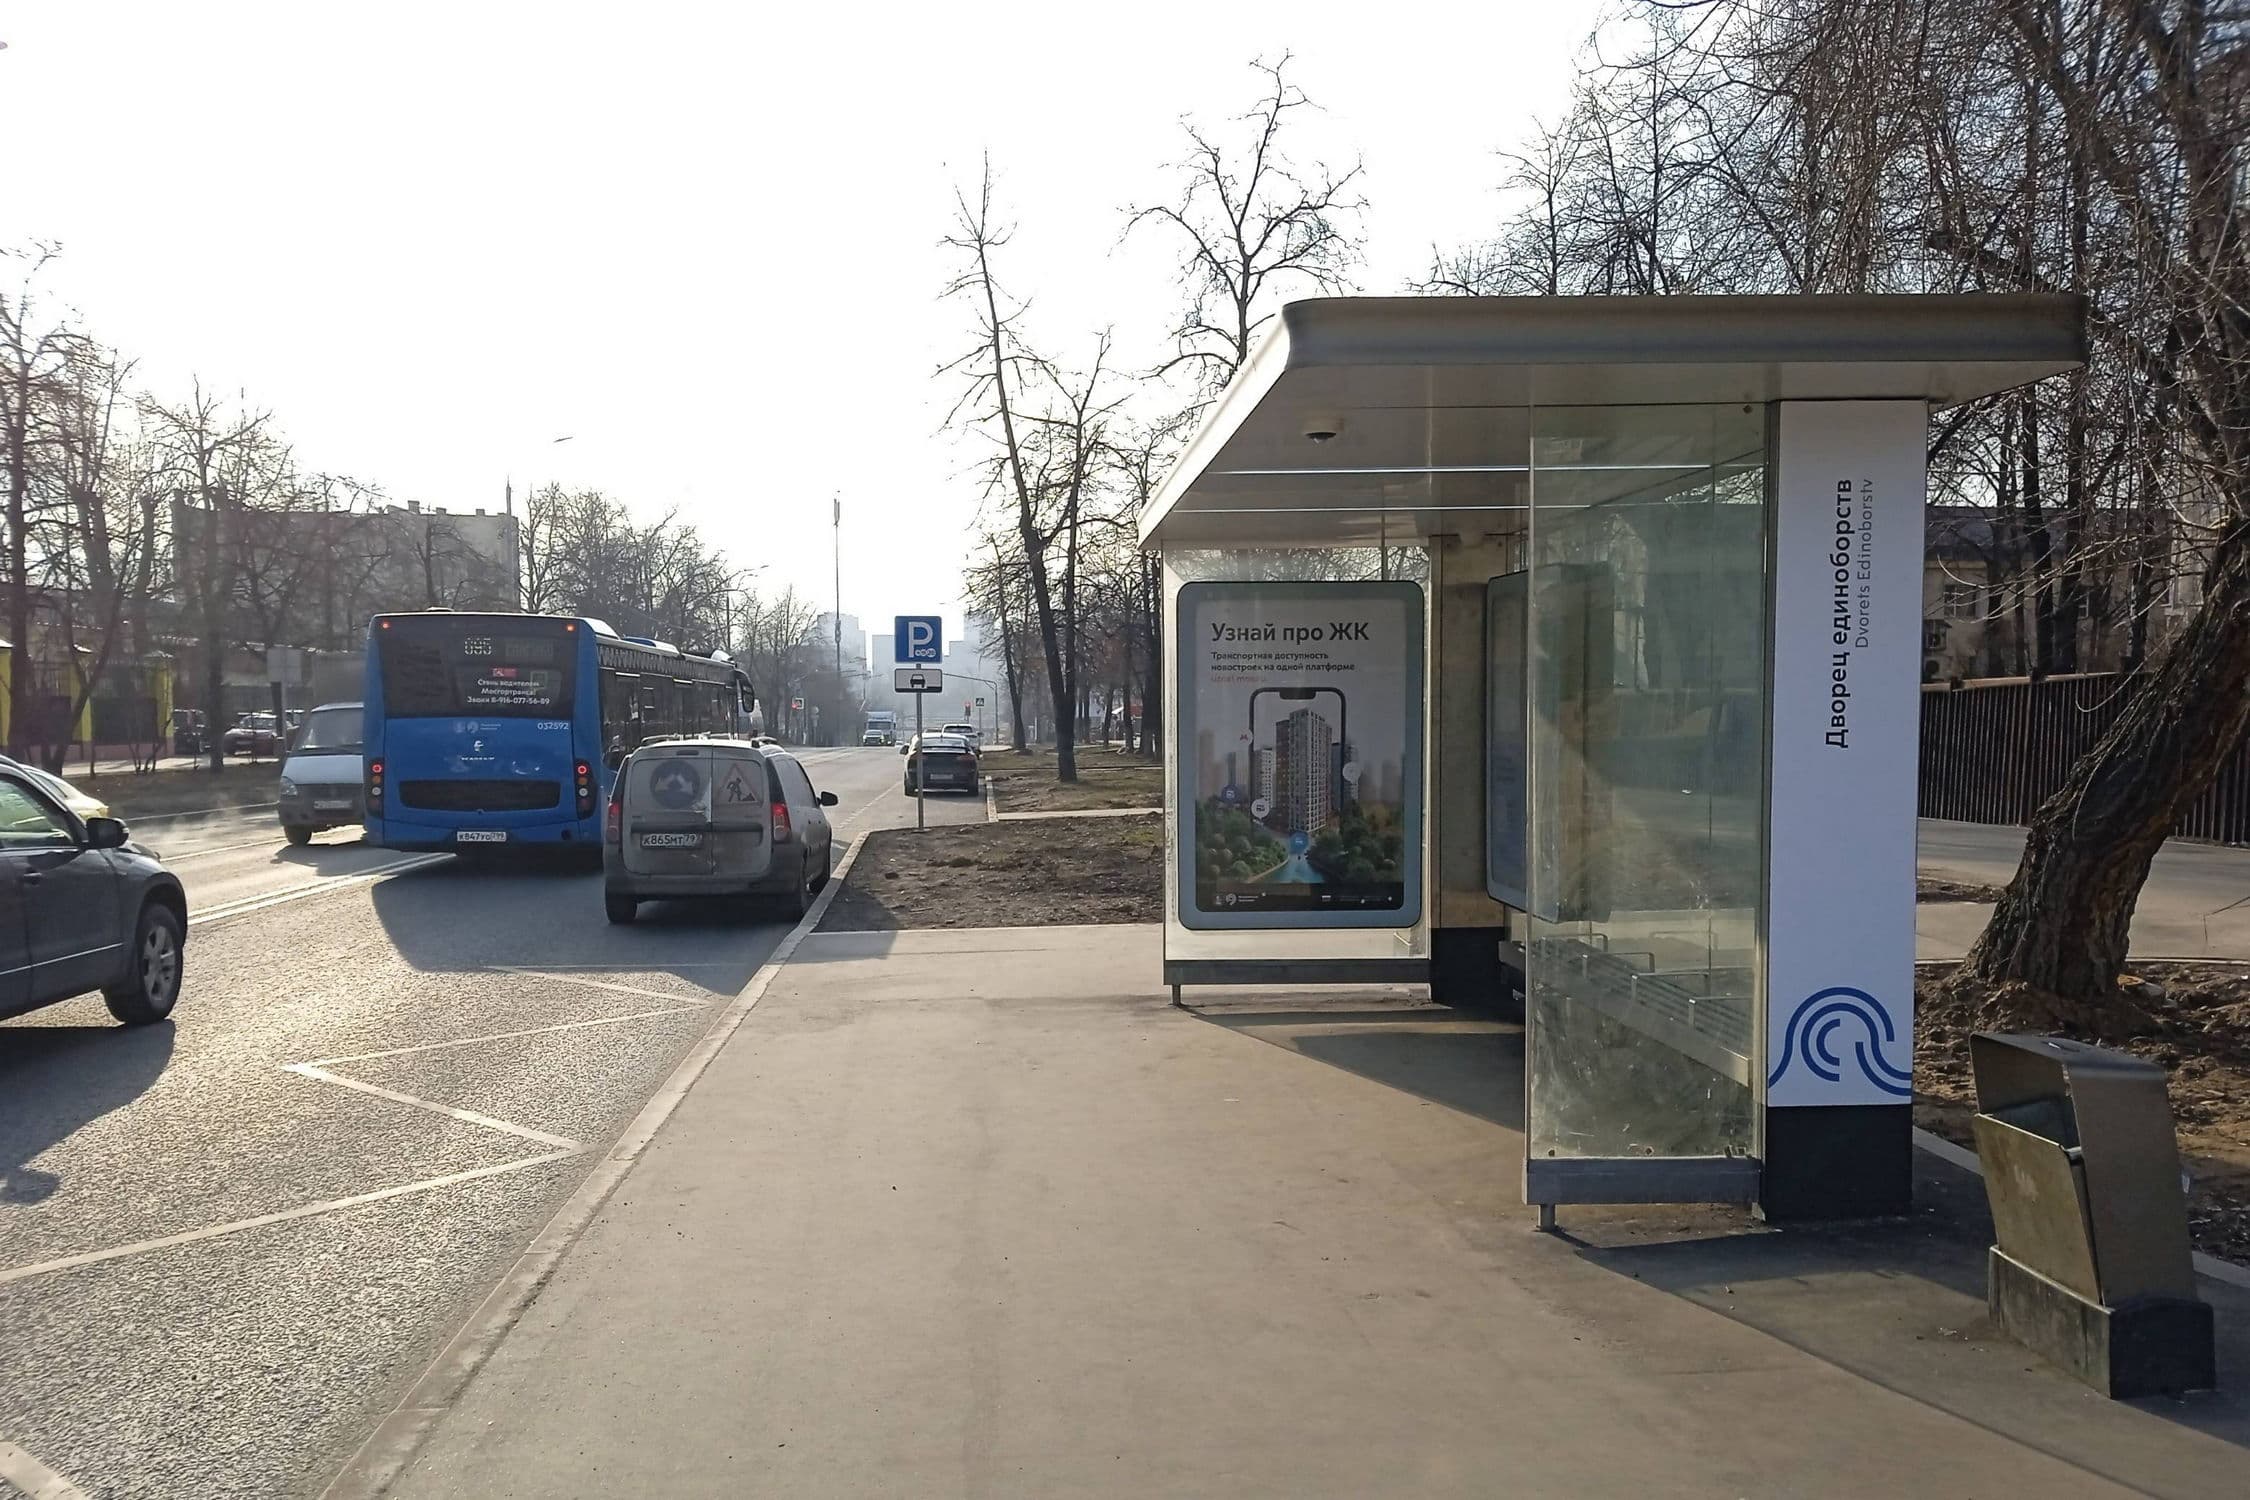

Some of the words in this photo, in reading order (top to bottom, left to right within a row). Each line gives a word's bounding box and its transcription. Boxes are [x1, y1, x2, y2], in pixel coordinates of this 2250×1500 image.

[1857, 478, 1875, 581] Edinoborstv
[1829, 478, 1854, 645] единоборств
[1211, 622, 1276, 642] Узнай
[1283, 626, 1324, 646] про
[1329, 622, 1370, 641] ЖК
[1855, 585, 1870, 649] Dvorets
[908, 621, 933, 658] P
[1211, 651, 1273, 661] Транспортная
[1274, 652, 1329, 661] доступность
[1211, 663, 1262, 673] новостроек
[1264, 664, 1275, 672] на
[1276, 662, 1302, 673] одной
[1305, 662, 1356, 673] платформе
[1825, 652, 1850, 749] Дворец
[537, 722, 569, 731] 032592
